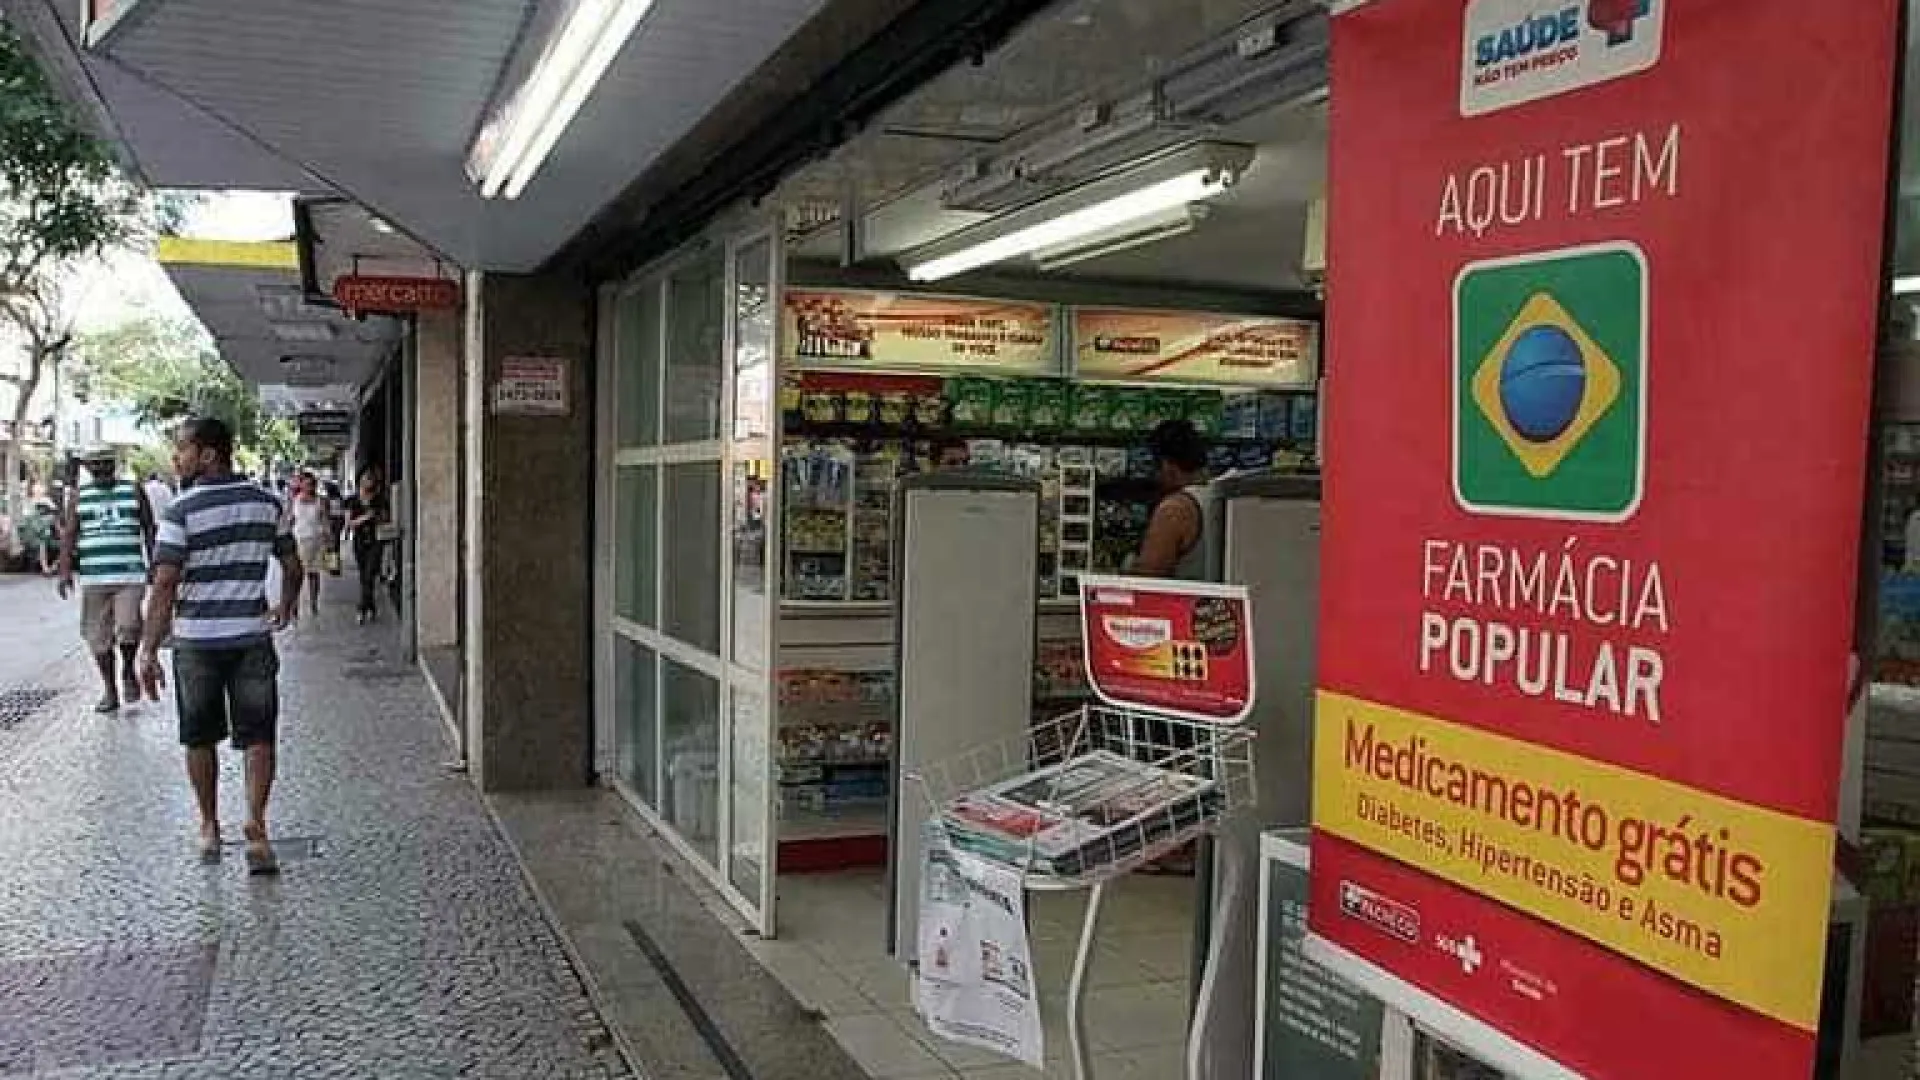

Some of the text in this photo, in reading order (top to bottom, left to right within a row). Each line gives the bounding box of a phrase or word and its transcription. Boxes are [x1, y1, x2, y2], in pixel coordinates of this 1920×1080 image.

[1474, 67, 1501, 86] NÃO
[1504, 59, 1530, 81] TEM
[1475, 6, 1581, 66] SAÚDE
[1436, 124, 1680, 238] AQUI TEM
[1422, 535, 1669, 634] FARMÁCIA
[1419, 614, 1664, 722] POPULAR
[1344, 718, 1763, 908] Medicamento grátis
[1358, 792, 1723, 960] Diabetes, Hipertensão e Asma
